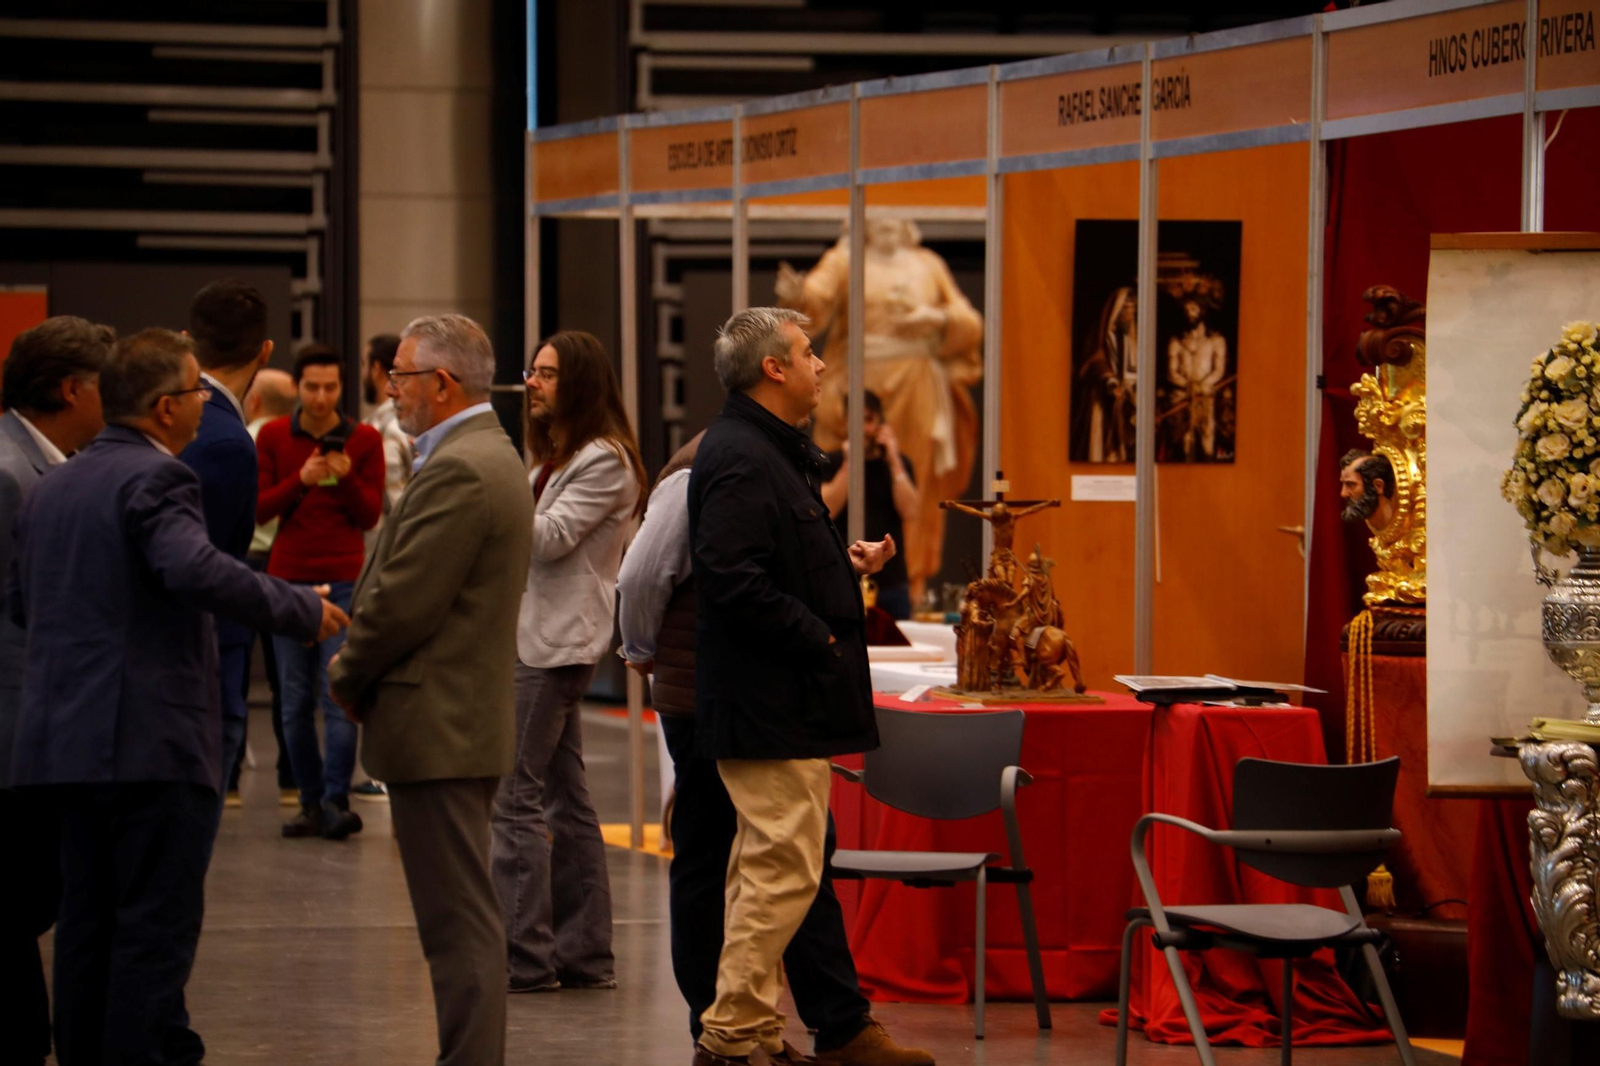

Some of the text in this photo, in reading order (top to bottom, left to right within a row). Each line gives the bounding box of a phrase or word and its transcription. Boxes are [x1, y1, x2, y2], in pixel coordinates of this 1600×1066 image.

[1429, 32, 1467, 77] HNOS
[1540, 11, 1595, 57] RIVERA
[1058, 89, 1097, 126] RAFAEL
